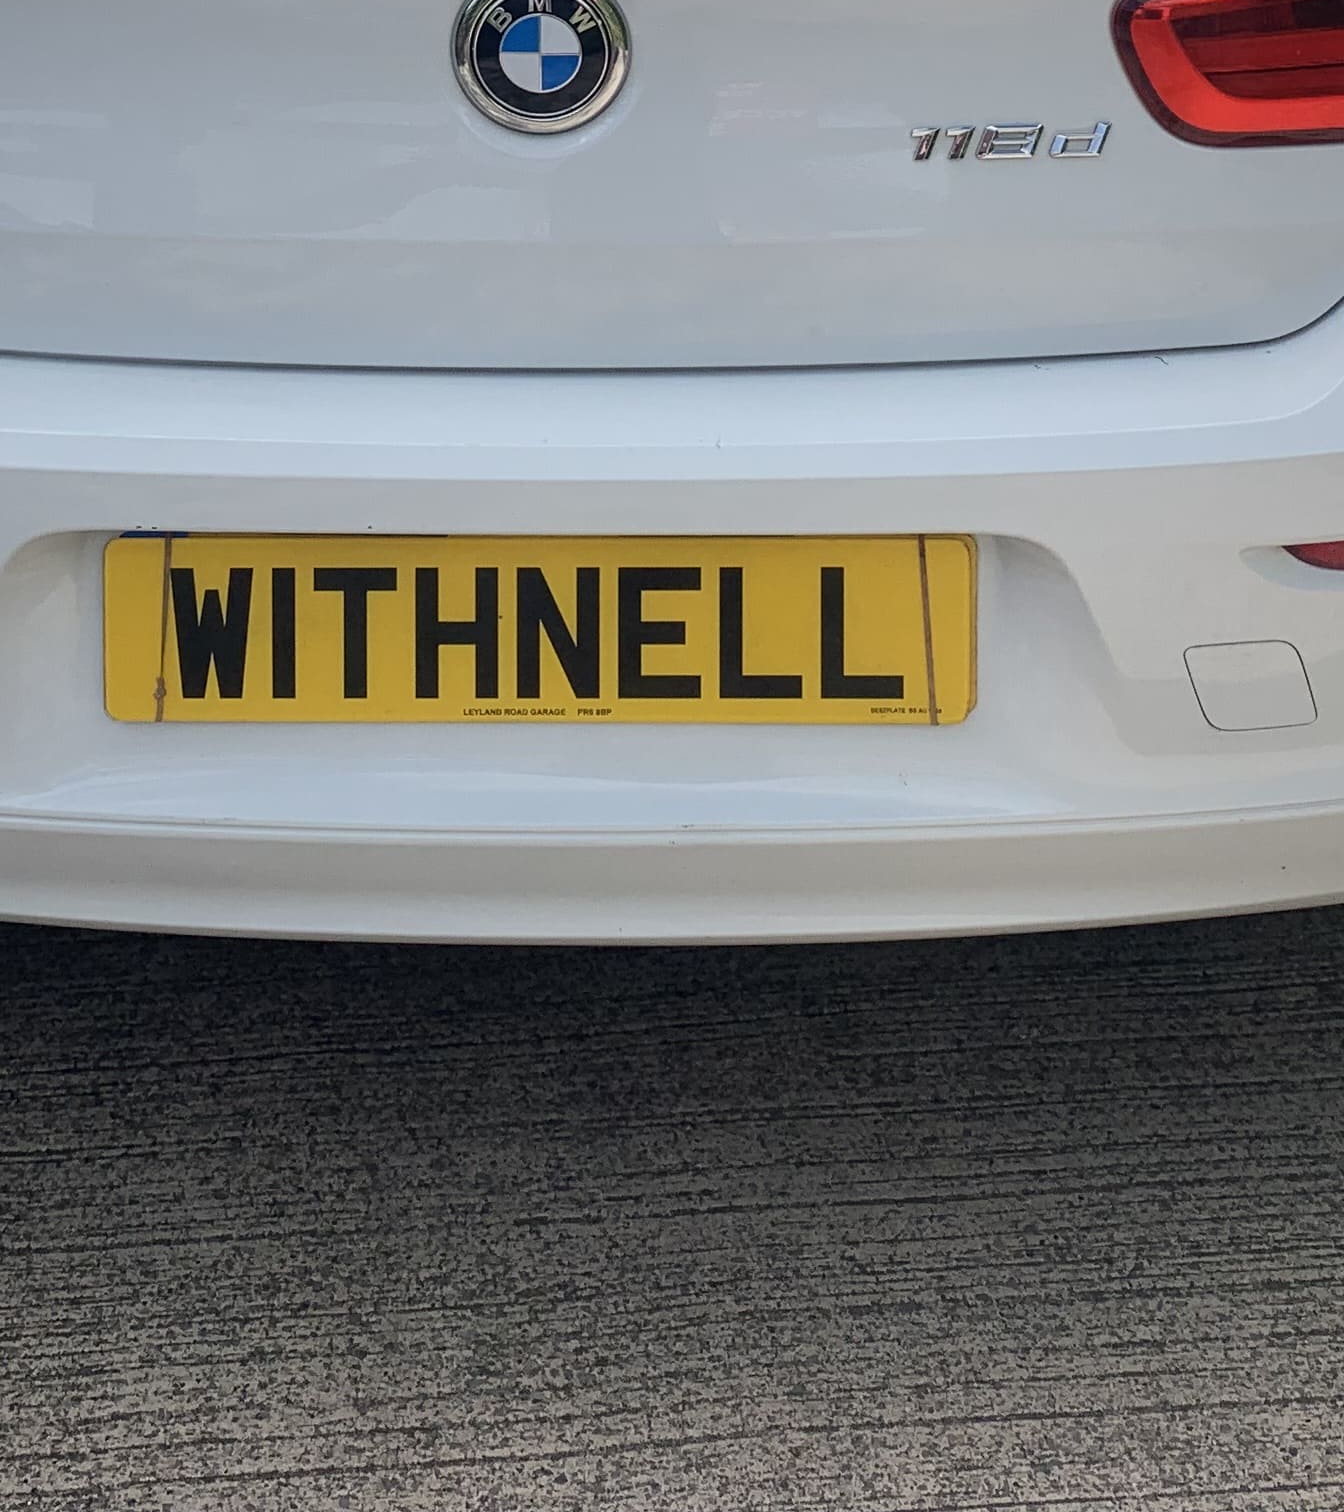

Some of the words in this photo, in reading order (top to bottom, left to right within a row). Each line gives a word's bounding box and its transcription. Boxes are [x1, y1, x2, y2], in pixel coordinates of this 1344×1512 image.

[911, 121, 1113, 160] 118d
[170, 566, 904, 700] WITHNELL
[463, 708, 503, 716] LEYLAND
[504, 708, 528, 716] ROAD
[530, 708, 566, 716] GARAGE
